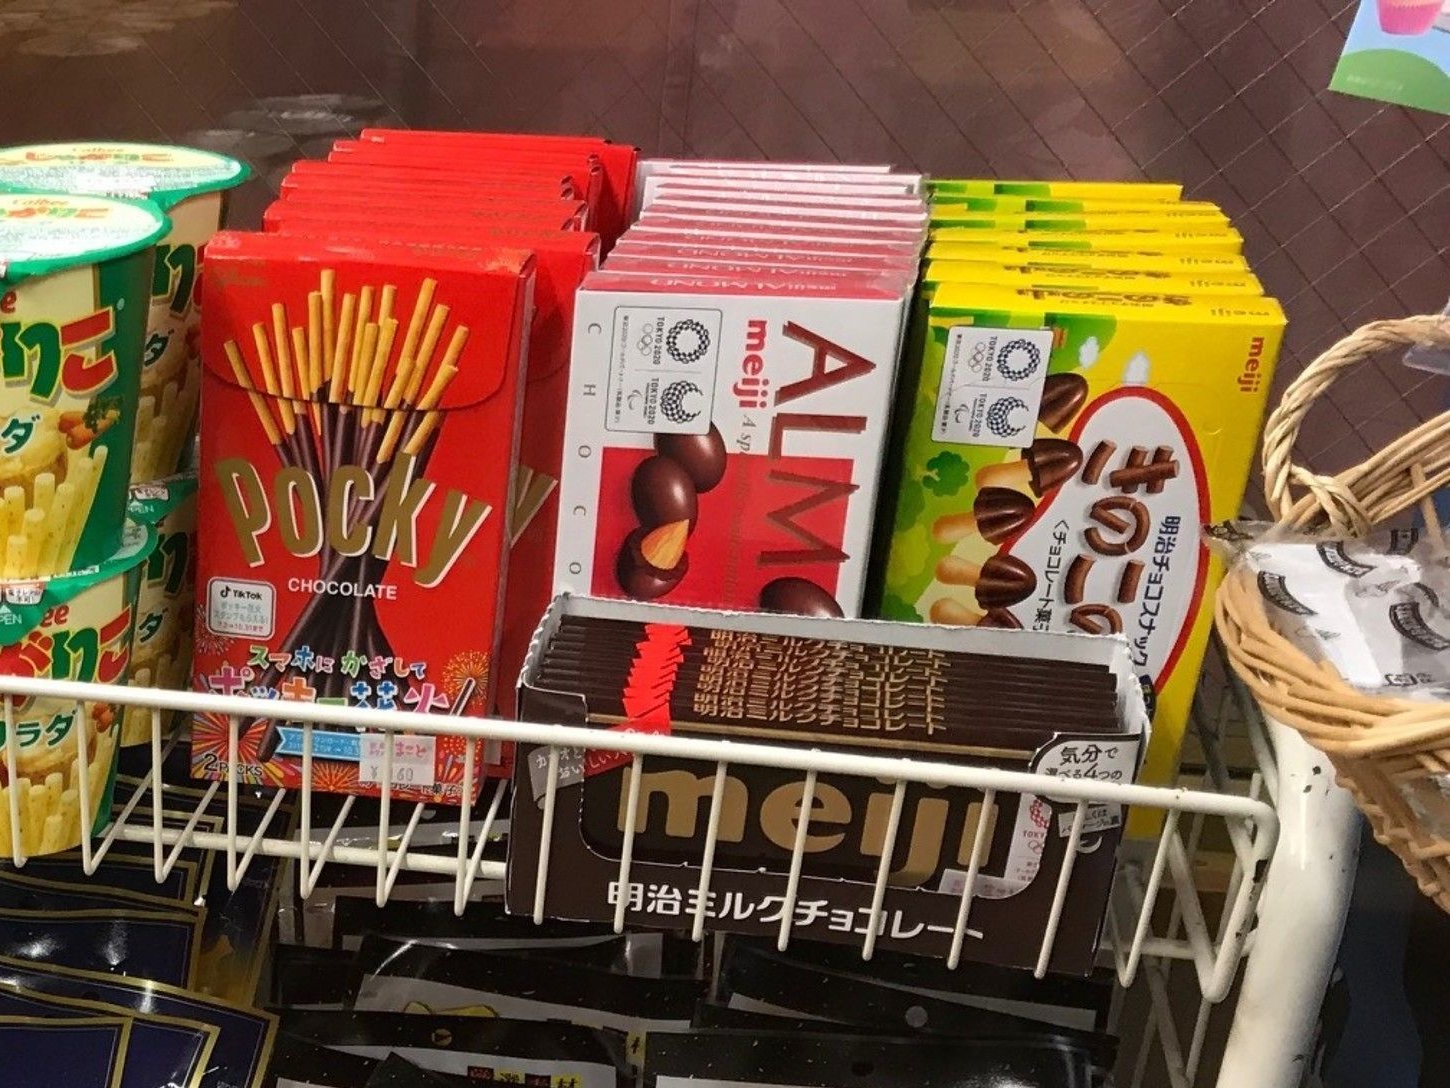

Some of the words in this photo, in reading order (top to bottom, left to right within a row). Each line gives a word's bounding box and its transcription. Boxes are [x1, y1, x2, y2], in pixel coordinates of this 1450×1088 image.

[655, 317, 665, 343] TOKYO
[731, 319, 770, 411] meiji
[1236, 335, 1265, 393] meiji
[233, 589, 263, 601] TikTok
[287, 577, 398, 601] CHOCOLATE
[1132, 515, 1182, 667] 明治チョコスナック
[1059, 743, 1119, 766] 気分で
[617, 765, 1000, 886] meiji
[607, 880, 985, 941] 明治ミルクチョコレート
